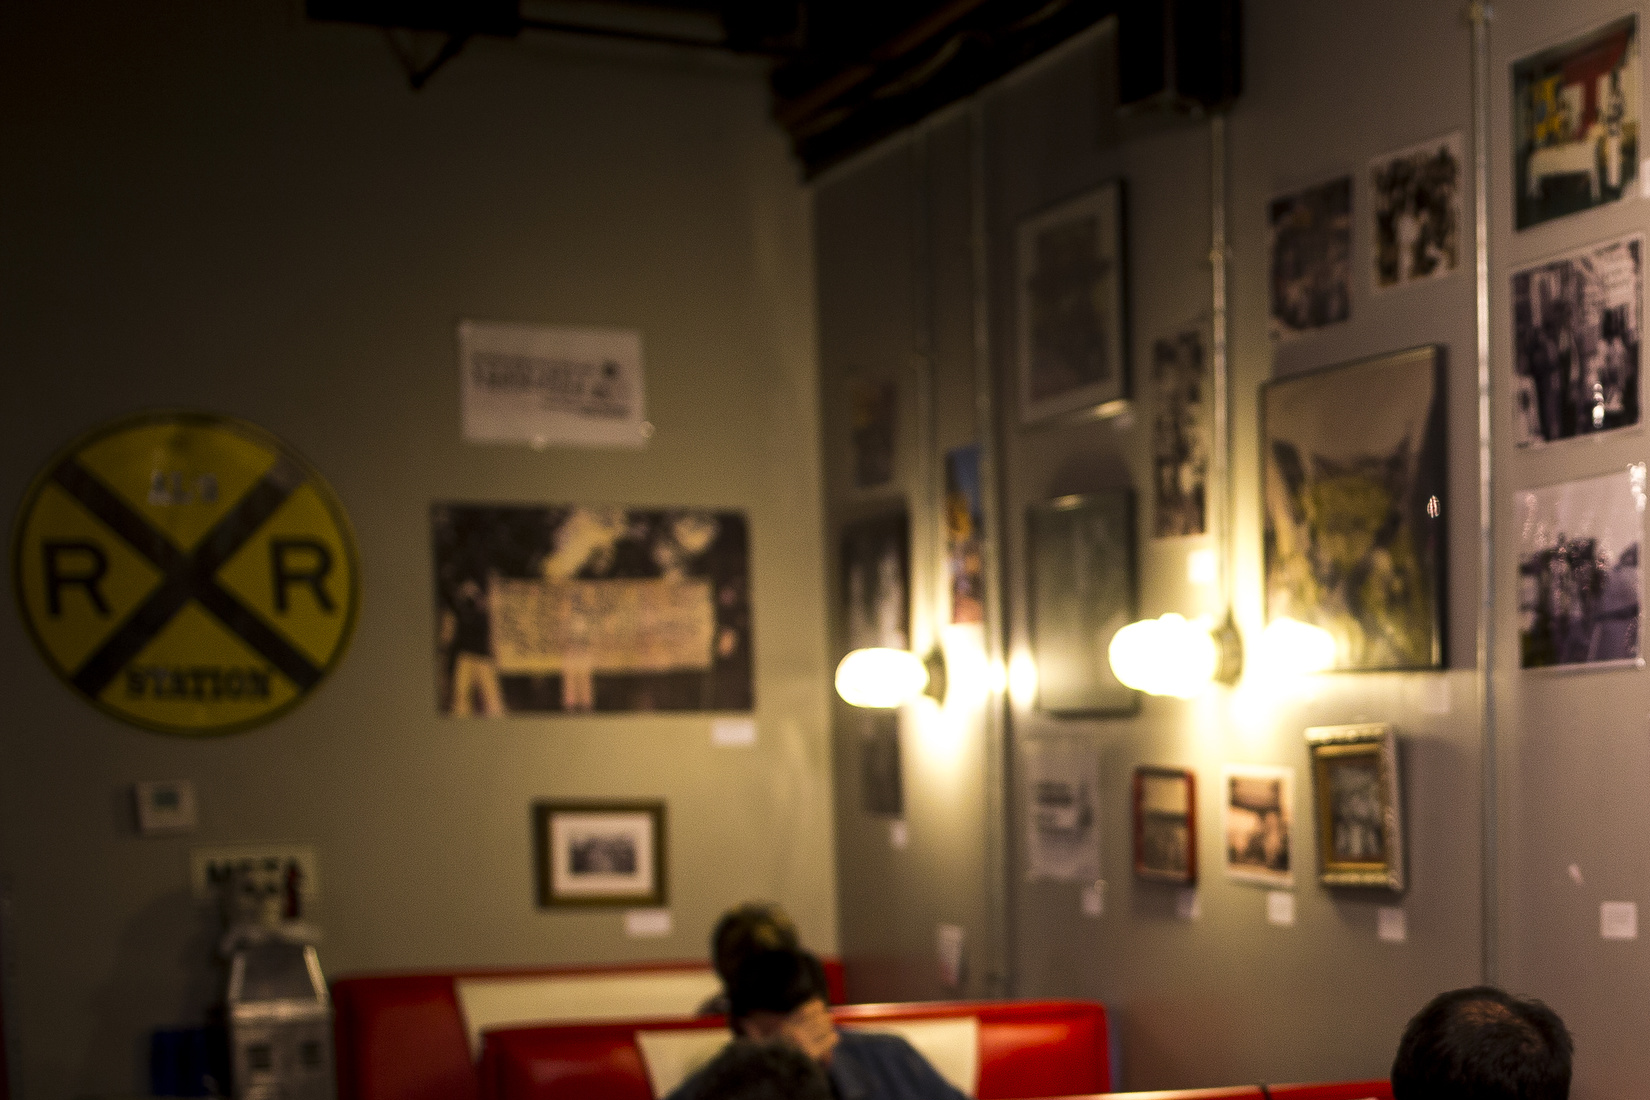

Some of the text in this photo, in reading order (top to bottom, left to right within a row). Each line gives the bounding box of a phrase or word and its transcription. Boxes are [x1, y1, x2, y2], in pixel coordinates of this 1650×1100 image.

[40, 535, 337, 620] R R
[126, 664, 272, 698] STATION
